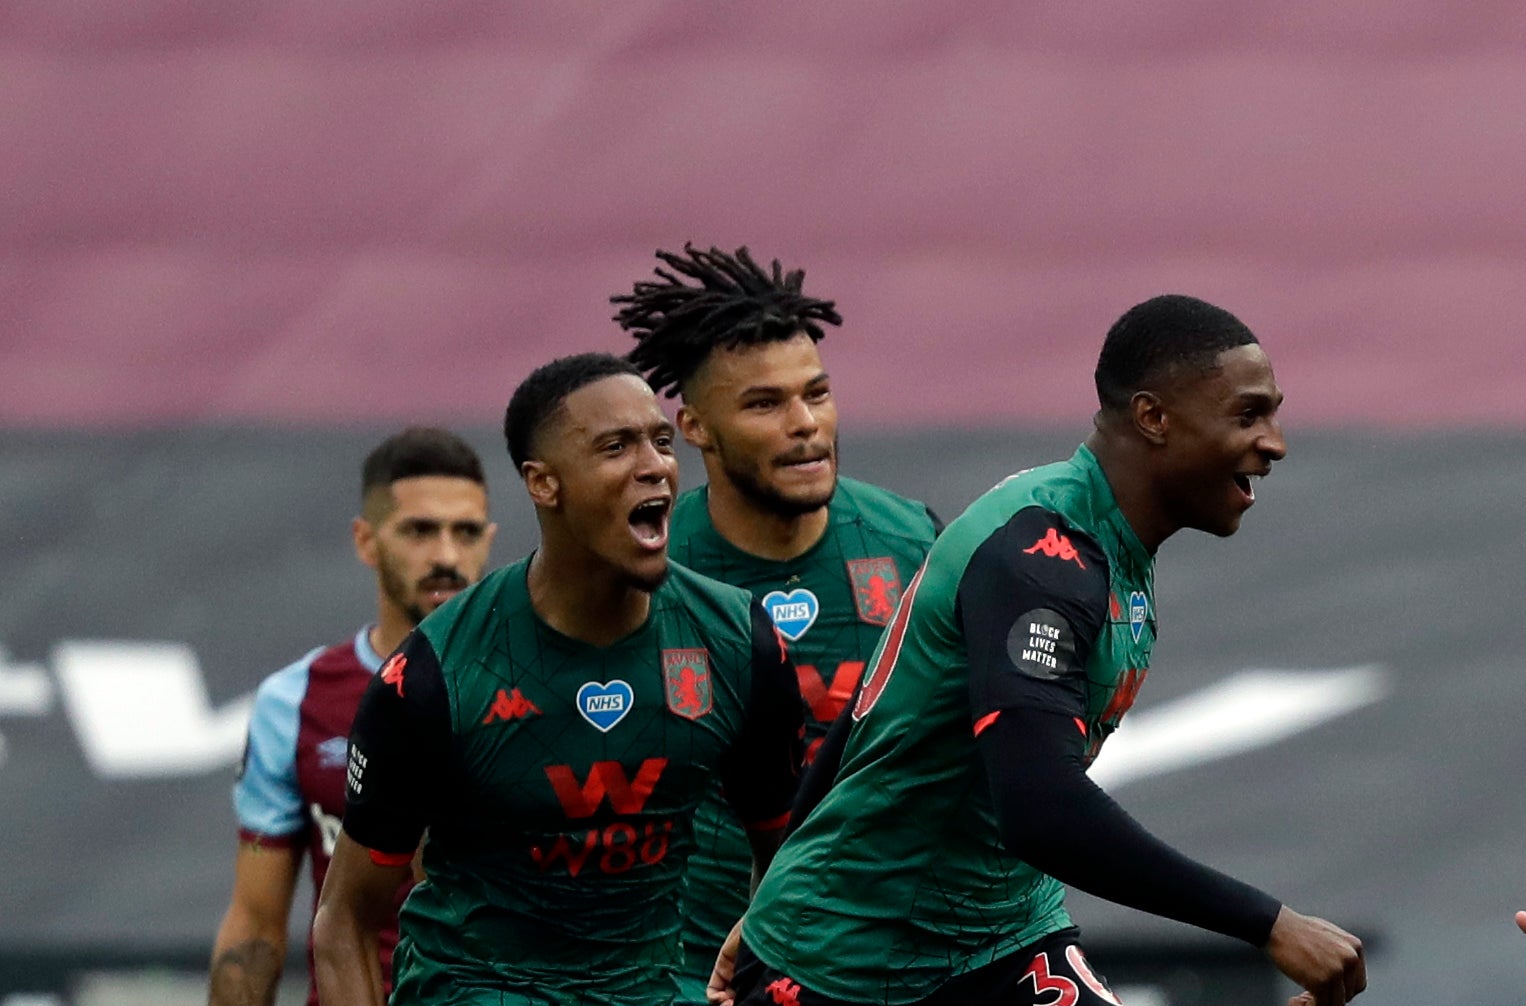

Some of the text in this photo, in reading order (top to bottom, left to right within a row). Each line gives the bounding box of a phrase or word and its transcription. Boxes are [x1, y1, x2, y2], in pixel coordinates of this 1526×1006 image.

[776, 603, 807, 619] NHS
[1029, 637, 1056, 652] LIVES
[1022, 649, 1057, 668] MATTER
[588, 695, 621, 711] NHS
